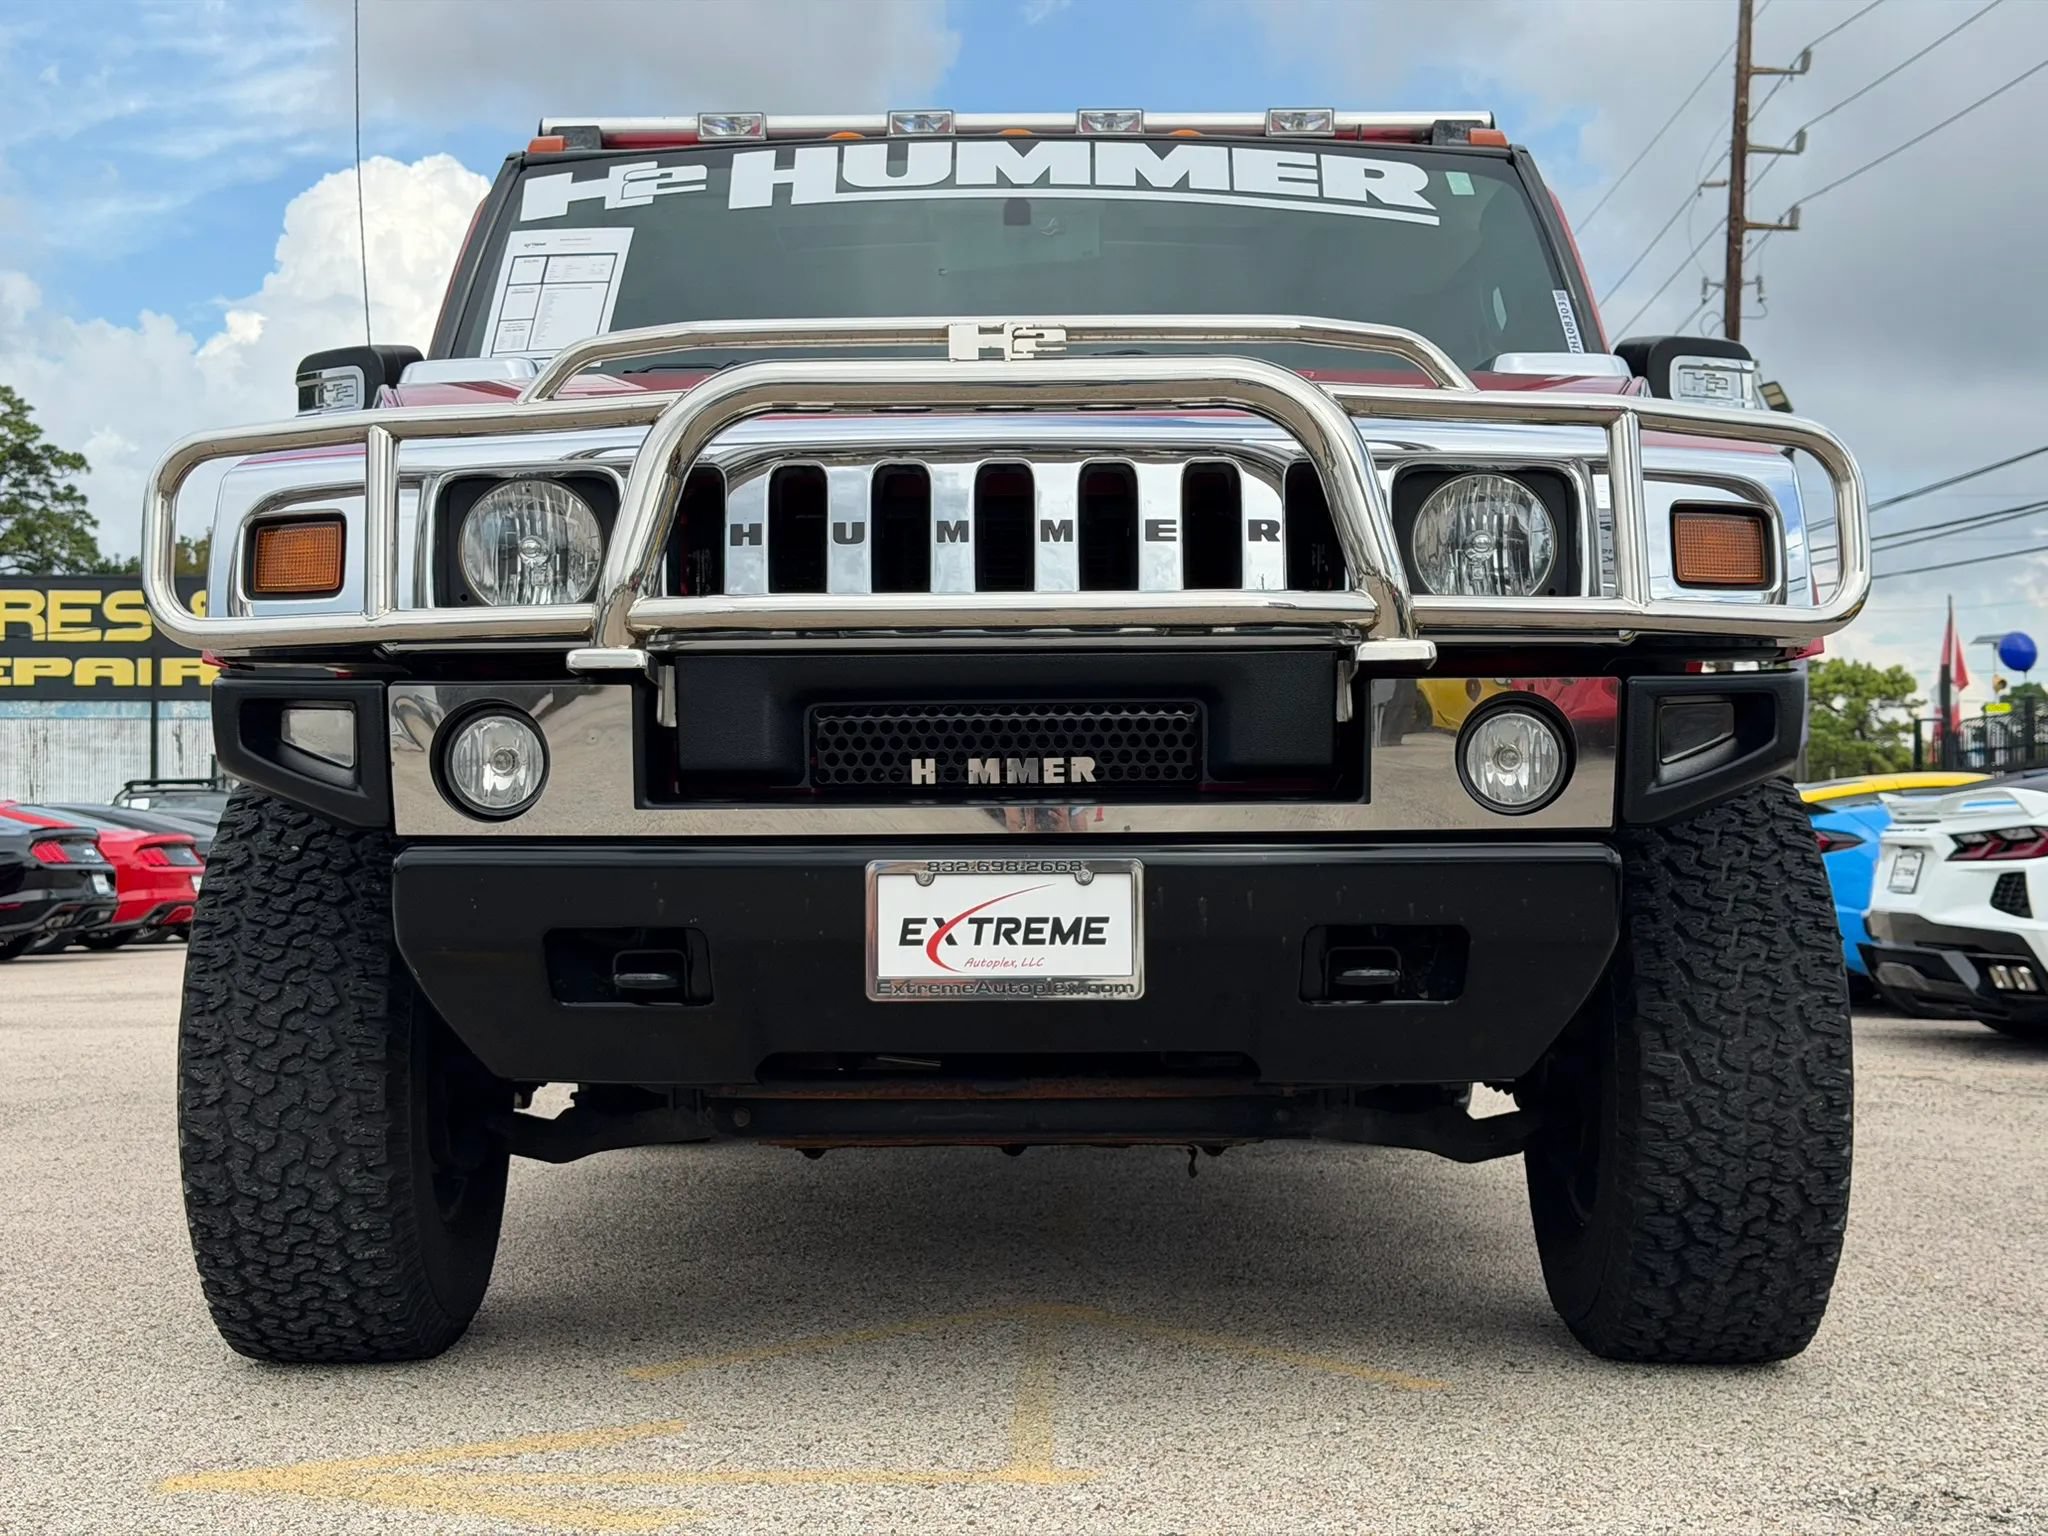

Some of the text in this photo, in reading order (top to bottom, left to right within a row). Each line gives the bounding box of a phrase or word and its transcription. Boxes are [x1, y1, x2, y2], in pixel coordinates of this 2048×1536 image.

[520, 141, 1439, 223] H2 HUMMER
[947, 321, 1067, 362] H2
[0, 657, 221, 687] PAIR
[899, 916, 1110, 946] EXTREME
[964, 957, 1045, 969] Autoplex, LLC
[876, 979, 1135, 997] ExtremeAutoplex.com
